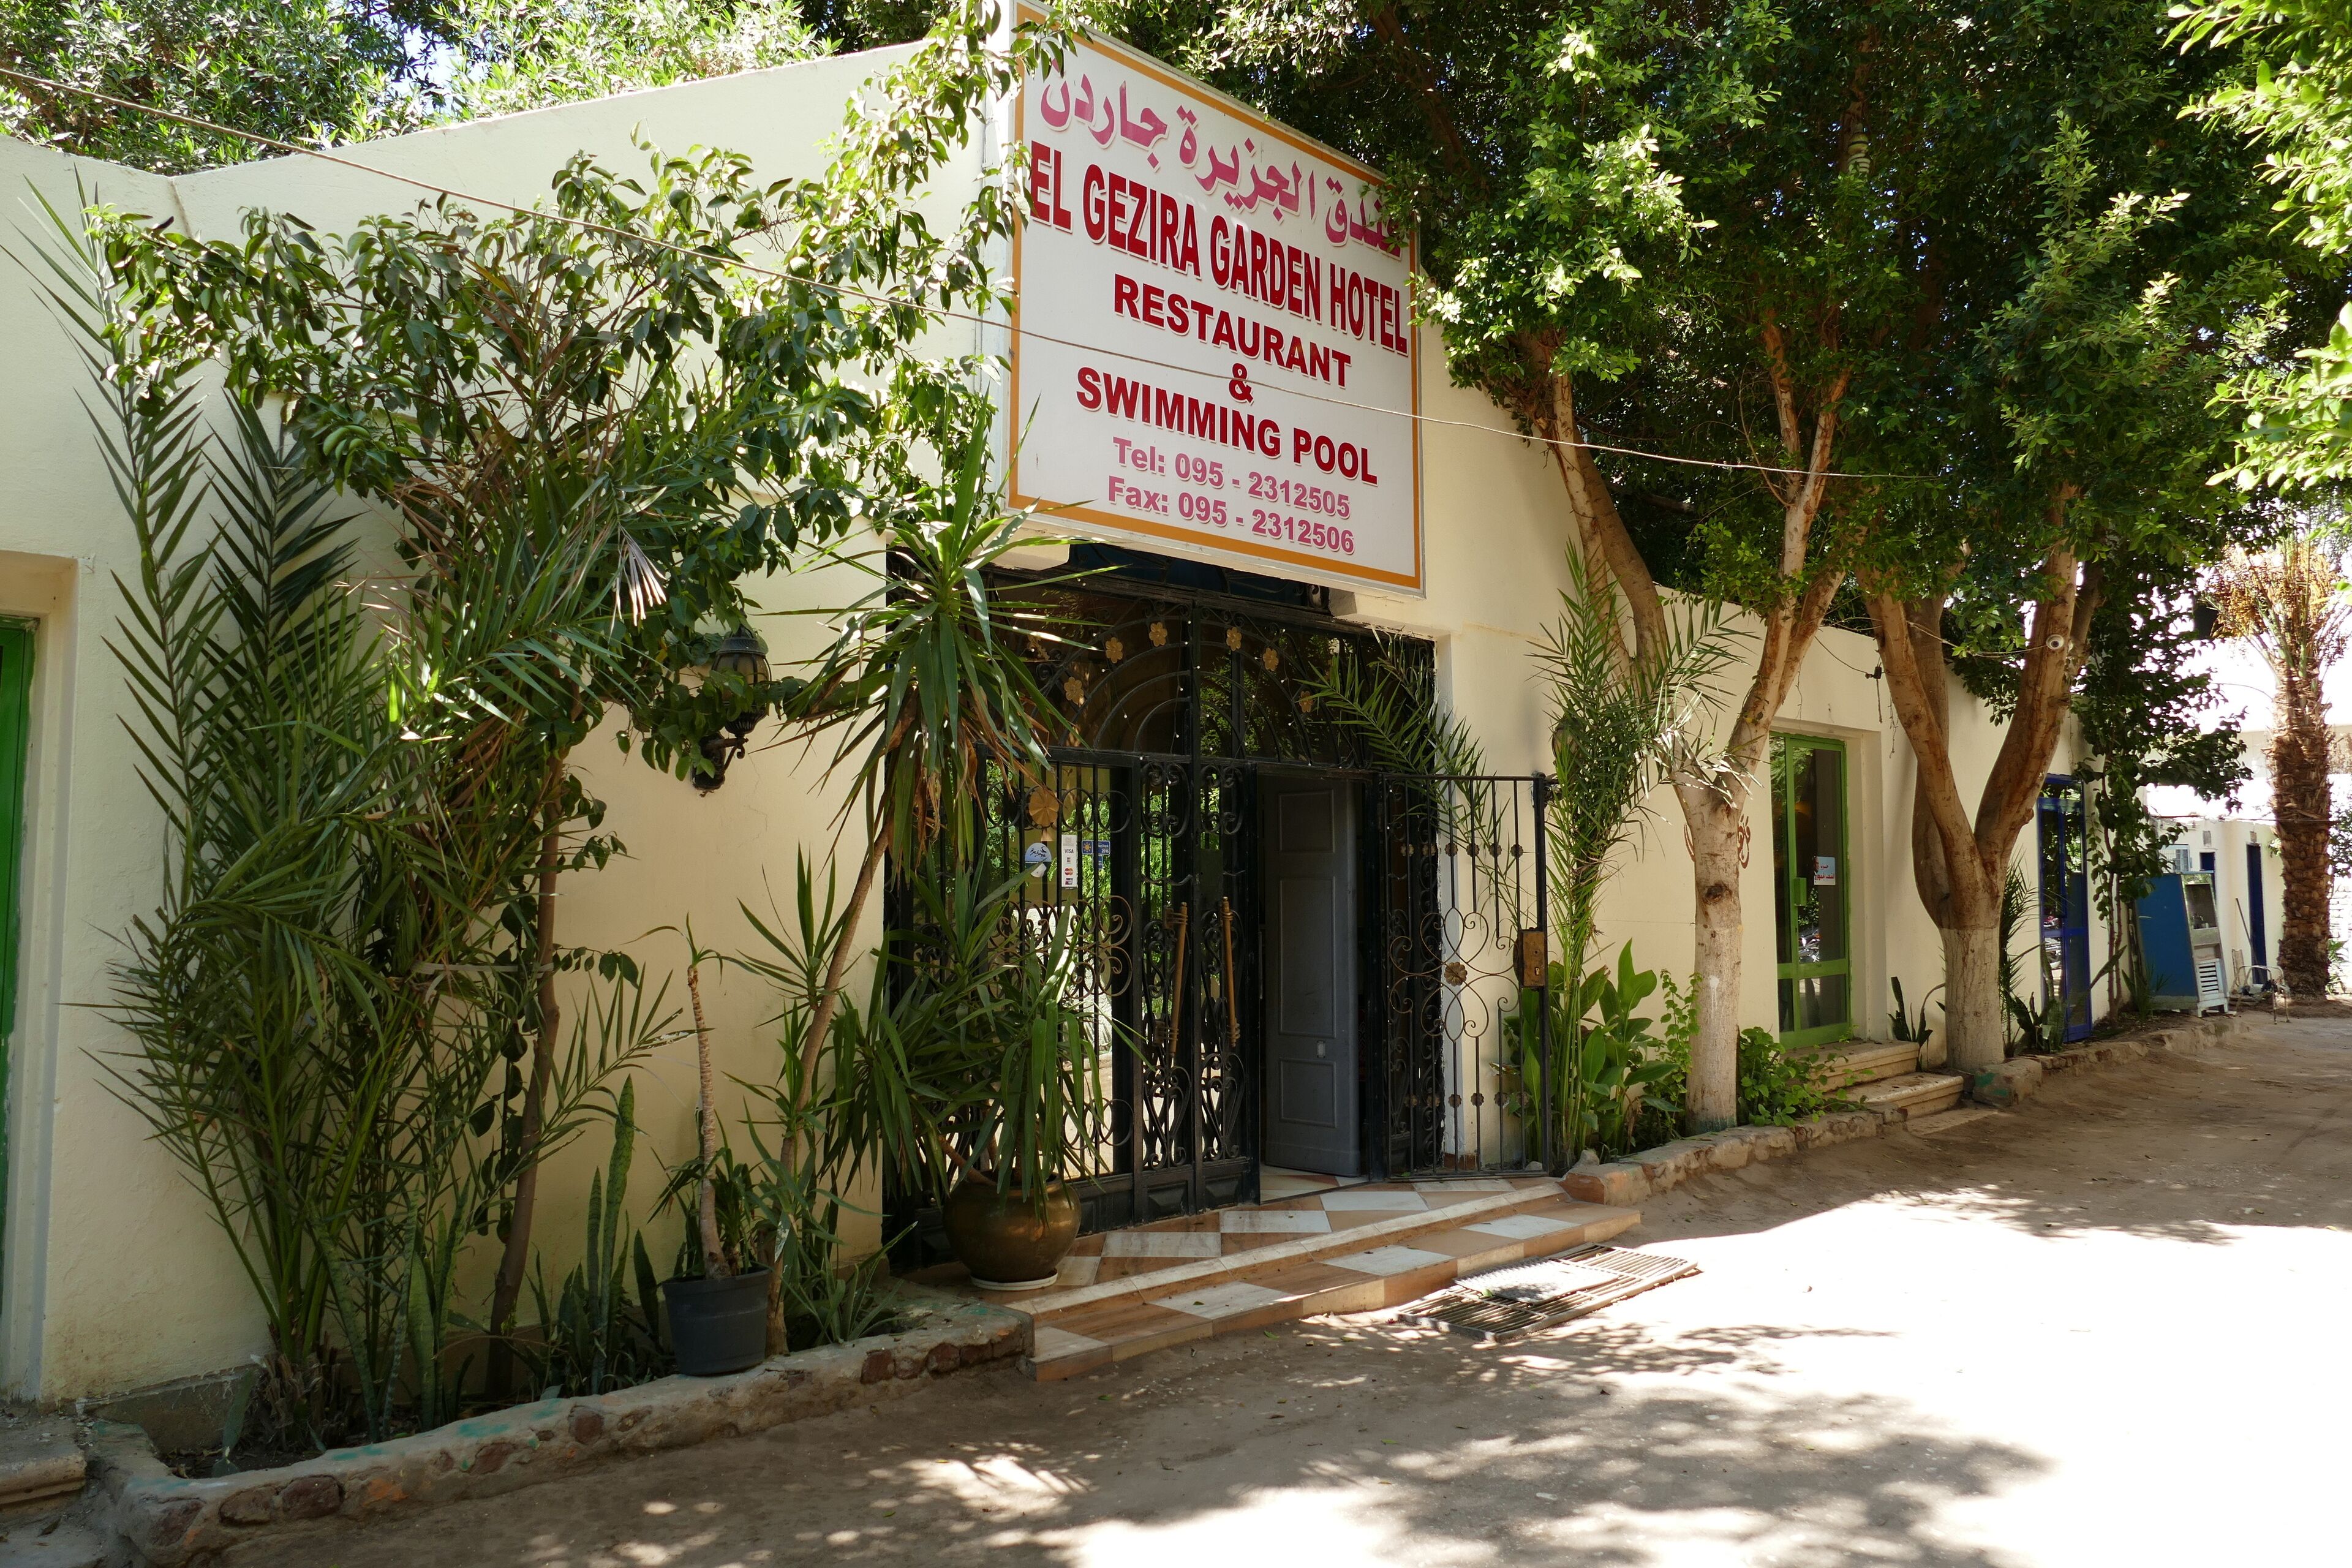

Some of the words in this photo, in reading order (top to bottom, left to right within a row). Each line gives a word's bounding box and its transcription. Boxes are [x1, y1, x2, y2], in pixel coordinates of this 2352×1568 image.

[1041, 58, 1167, 169] جاردن
[1176, 105, 1316, 221] الجزيرة
[1030, 140, 1072, 230] EL
[1083, 164, 1201, 277] GEZIRA
[1210, 215, 1321, 321] GARDEN
[1330, 263, 1408, 354] HOTEL
[1114, 274, 1351, 388] RESTAURANT
[1229, 363, 1254, 402] &
[1077, 367, 1281, 458] SWIMMING
[1293, 428, 1378, 486] POOL
[1114, 437, 1165, 475] Tel:
[1175, 453, 1224, 488] 095
[1248, 472, 1351, 518] 2312505
[1109, 475, 1169, 513] Fax:
[1178, 492, 1227, 526] 095
[1251, 509, 1355, 554] 2312506
